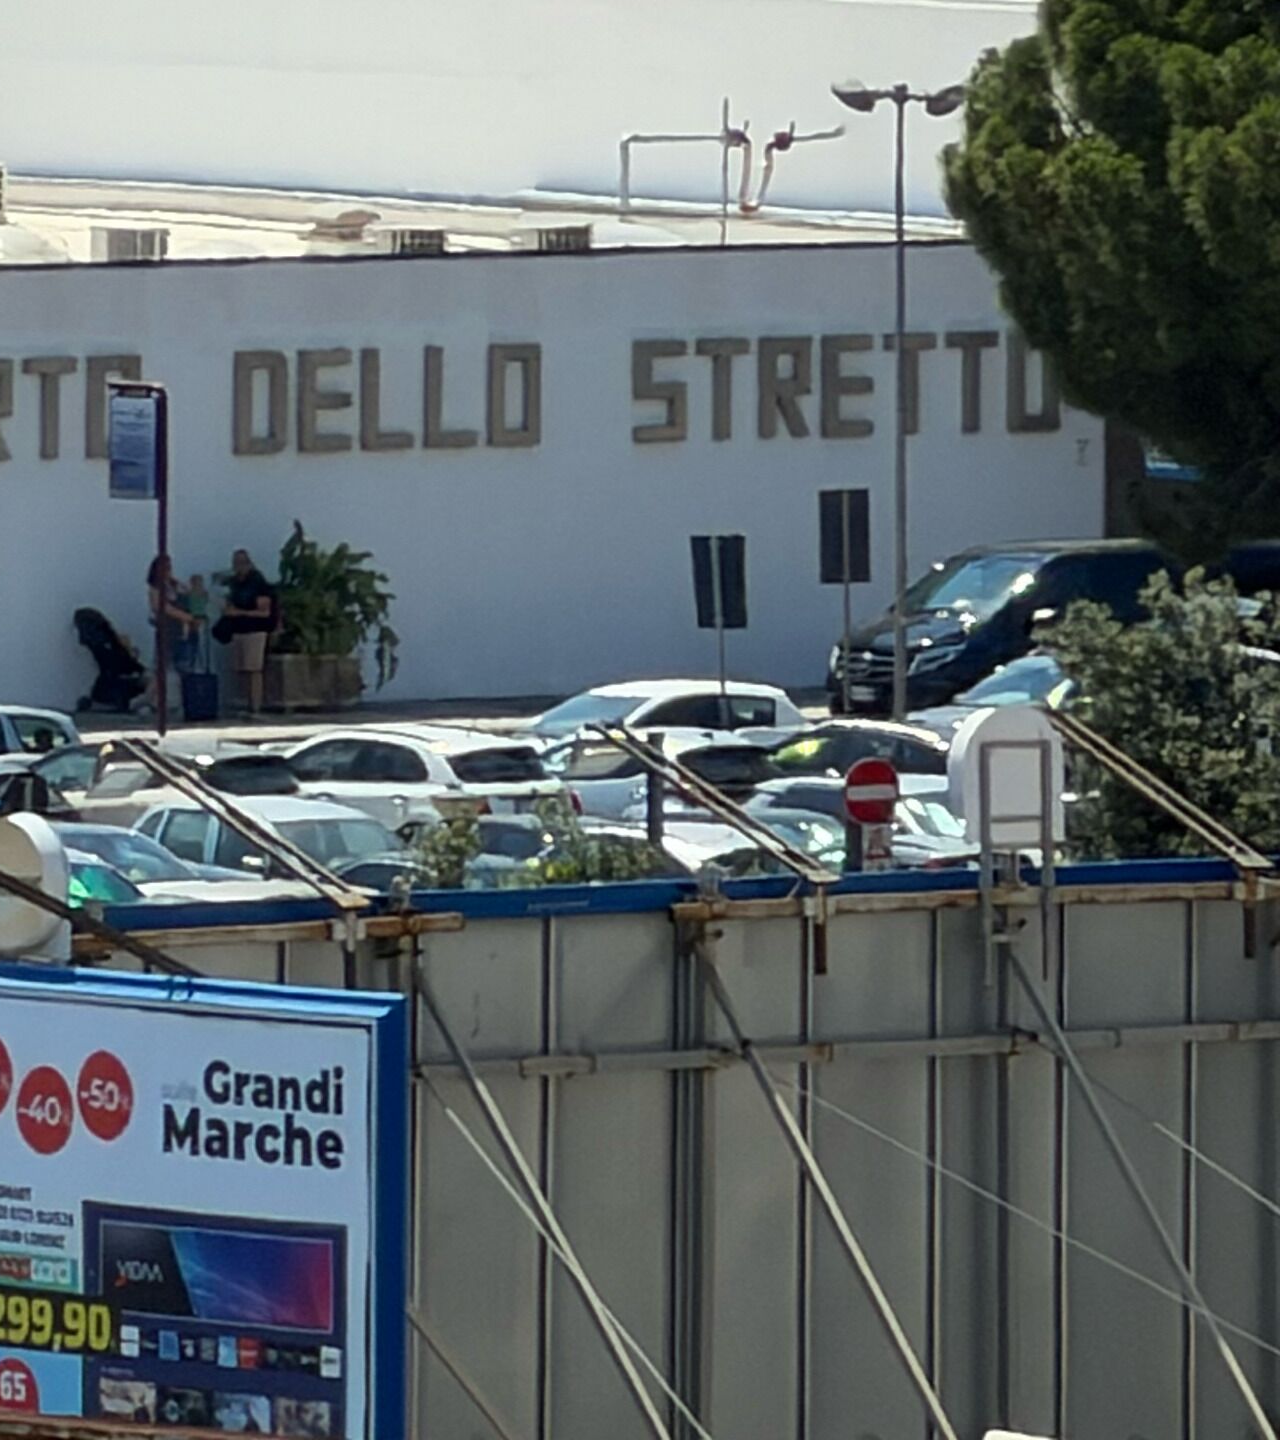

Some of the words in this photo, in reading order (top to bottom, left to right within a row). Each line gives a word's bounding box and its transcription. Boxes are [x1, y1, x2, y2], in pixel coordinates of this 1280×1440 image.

[232, 342, 542, 455] DELLO
[632, 329, 1061, 443] STRETTO
[203, 1060, 344, 1115] Grandi
[162, 1103, 345, 1170] Marche
[0, 1371, 26, 1402] 65
